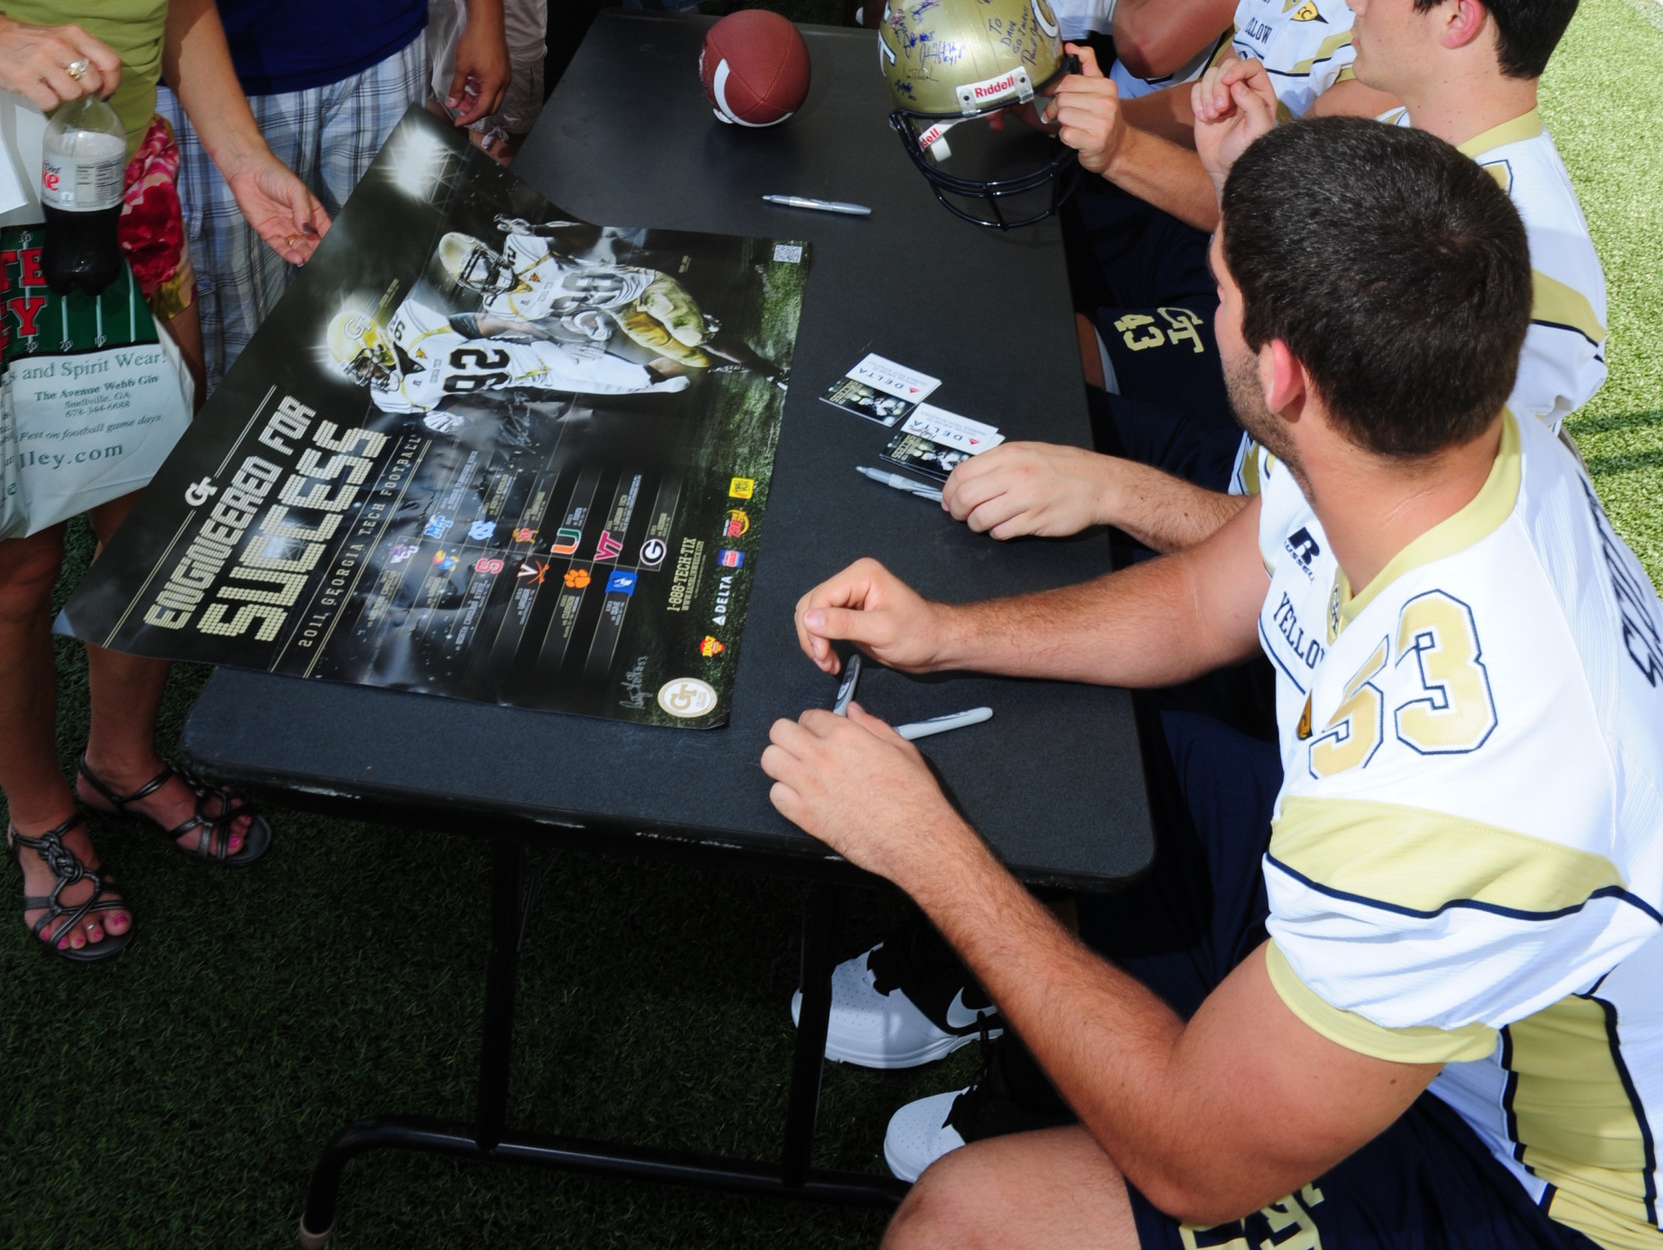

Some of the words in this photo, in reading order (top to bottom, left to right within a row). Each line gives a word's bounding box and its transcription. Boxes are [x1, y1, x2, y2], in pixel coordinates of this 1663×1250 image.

[974, 75, 1015, 99] Riddell
[22, 362, 55, 380] and
[60, 358, 110, 380] Spirit
[115, 351, 168, 368] Wear!
[443, 348, 511, 395] 92
[858, 367, 905, 390] DELTA
[34, 391, 57, 402] The
[59, 385, 101, 399] Avenue
[61, 424, 104, 440] football
[106, 420, 137, 433] game
[913, 419, 964, 442] DELTA
[143, 454, 284, 631] ENGINEERED
[258, 395, 317, 456] FOR
[196, 419, 388, 643] SUCCESS
[297, 611, 333, 648] 2011
[320, 542, 363, 607] GEORGIA
[357, 503, 386, 539] TECH
[379, 434, 422, 498] FOOTBALL
[1287, 526, 1321, 567] R
[667, 537, 697, 612] 1-888-TECH-TIX
[714, 575, 733, 615] DELTA
[1308, 588, 1498, 781] 53
